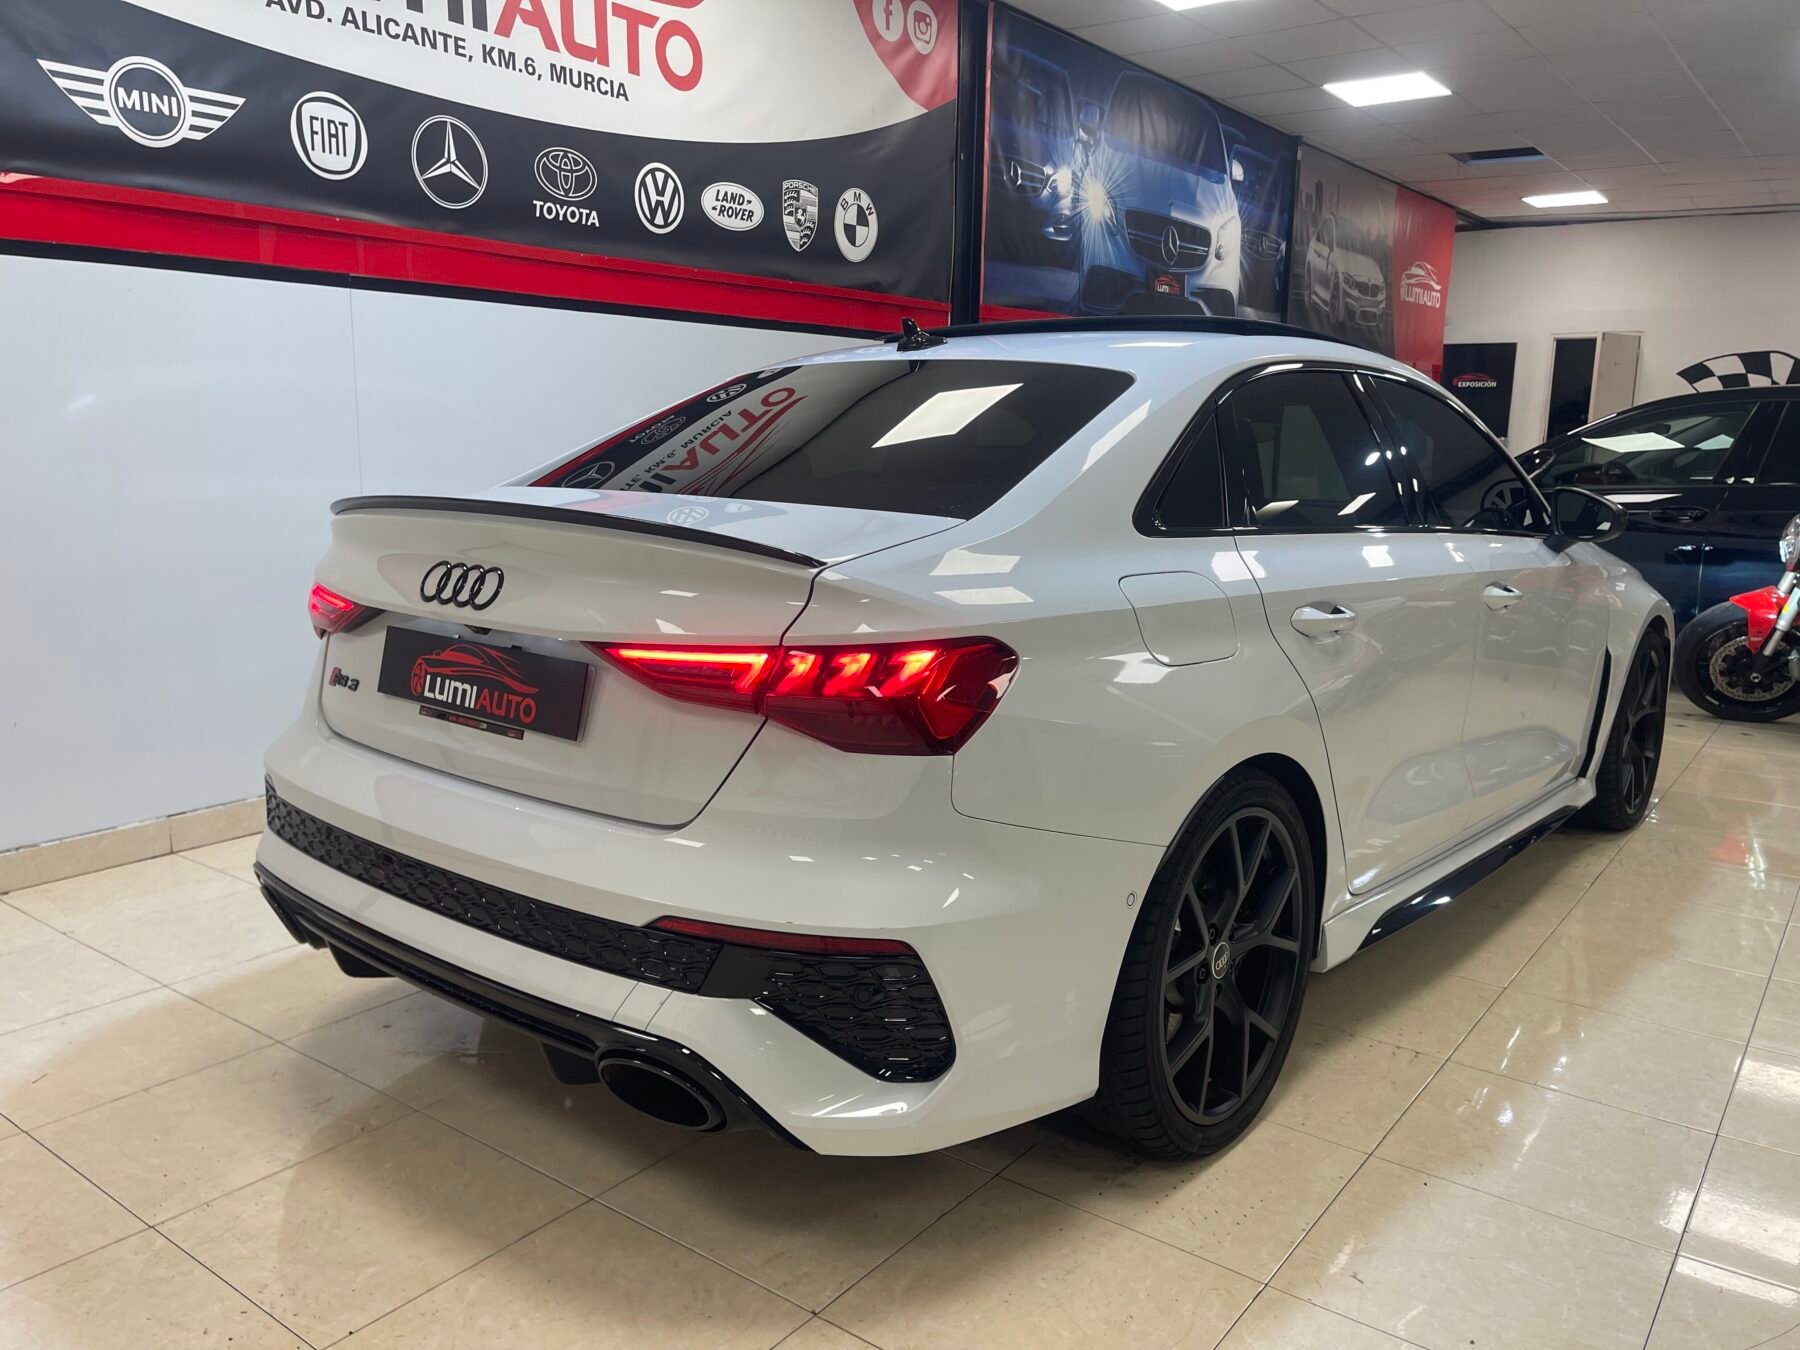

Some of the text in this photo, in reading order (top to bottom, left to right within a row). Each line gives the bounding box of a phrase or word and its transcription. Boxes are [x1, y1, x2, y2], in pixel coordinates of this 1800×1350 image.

[341, 6, 473, 62] ALICANTE,
[481, 43, 543, 81] KM.6,
[550, 62, 629, 101] MURCIA
[116, 86, 179, 118] MINI
[309, 115, 349, 157] FIAT
[715, 189, 745, 206] LAND
[840, 191, 874, 217] BMW
[532, 200, 600, 227] TOYOTA
[718, 205, 755, 223] ROVER
[1458, 379, 1497, 388] EXPOSICIÓN
